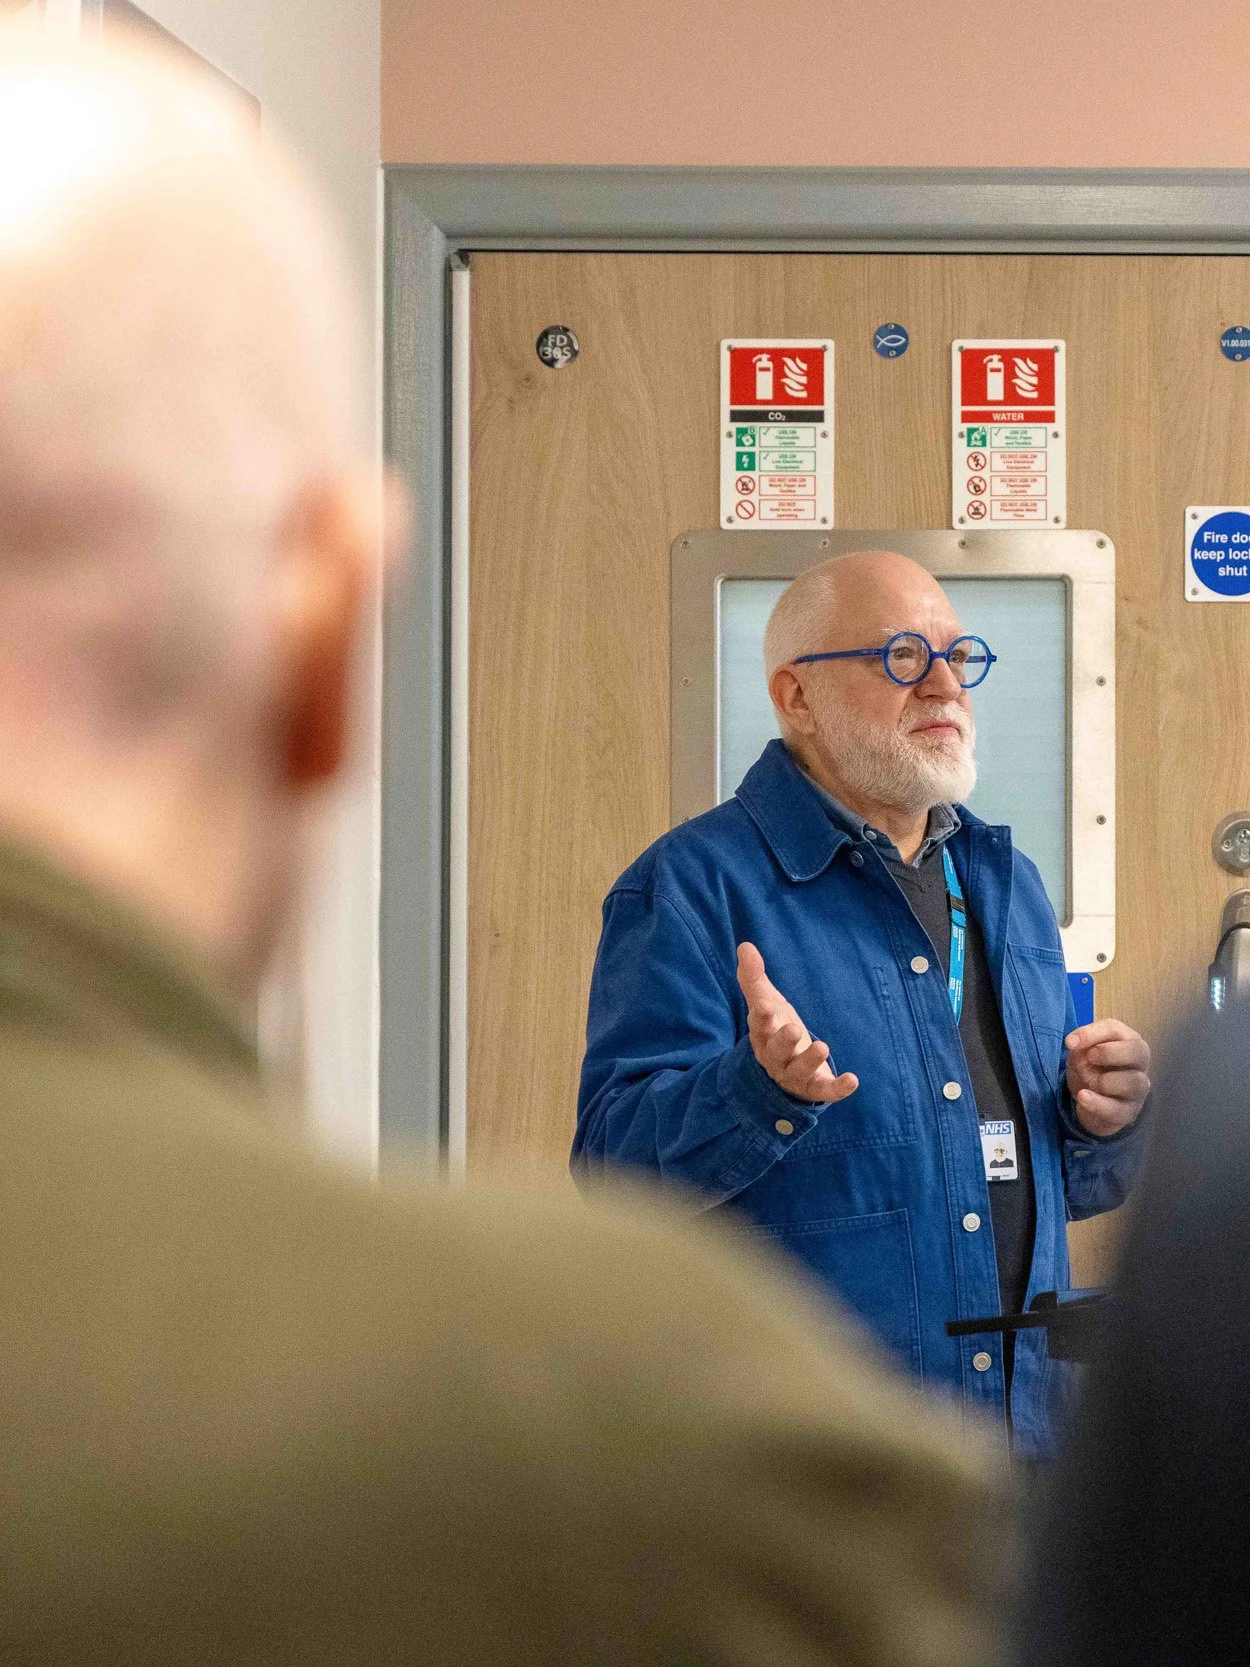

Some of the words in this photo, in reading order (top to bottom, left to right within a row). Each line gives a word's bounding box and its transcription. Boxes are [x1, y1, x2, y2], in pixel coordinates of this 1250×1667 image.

[548, 334, 568, 347] FD
[992, 412, 1024, 420] WATER
[1203, 531, 1228, 543] Fire
[1194, 548, 1225, 562] keep
[1218, 565, 1248, 576] shut
[985, 1123, 1011, 1134] NHS
